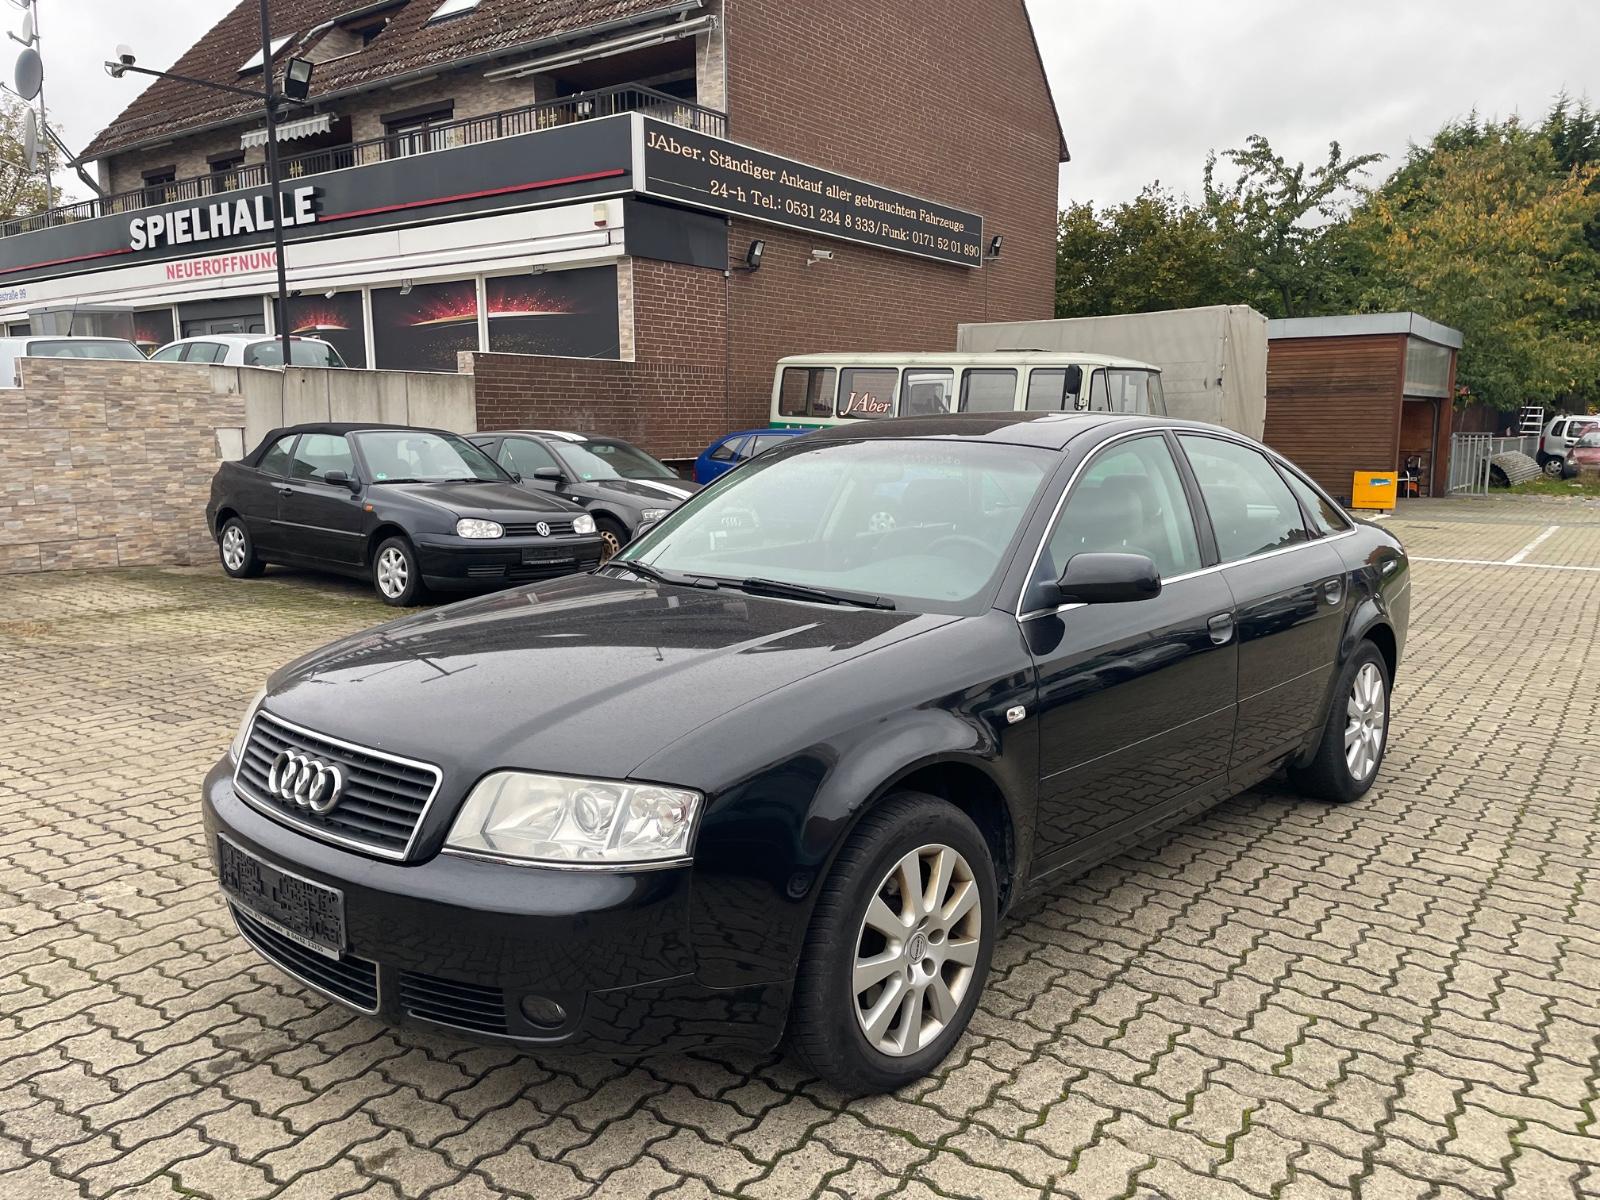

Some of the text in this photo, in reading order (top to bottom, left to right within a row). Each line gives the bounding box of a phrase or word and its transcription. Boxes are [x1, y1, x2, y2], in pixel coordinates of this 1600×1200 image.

[647, 131, 964, 232] JAber. Ständiger Ankauf aller gebrauchten Fahrzeuge
[129, 186, 316, 251] SPIELHALLE
[709, 179, 747, 203] 24-h
[750, 190, 782, 210] Tel.:
[785, 199, 816, 219] 0531
[819, 208, 841, 226] 234
[844, 214, 852, 228] 8
[912, 231, 935, 248] 0171
[937, 237, 949, 251] 52
[950, 240, 961, 254] 01
[963, 243, 980, 258] 890
[839, 391, 891, 417] JAber
